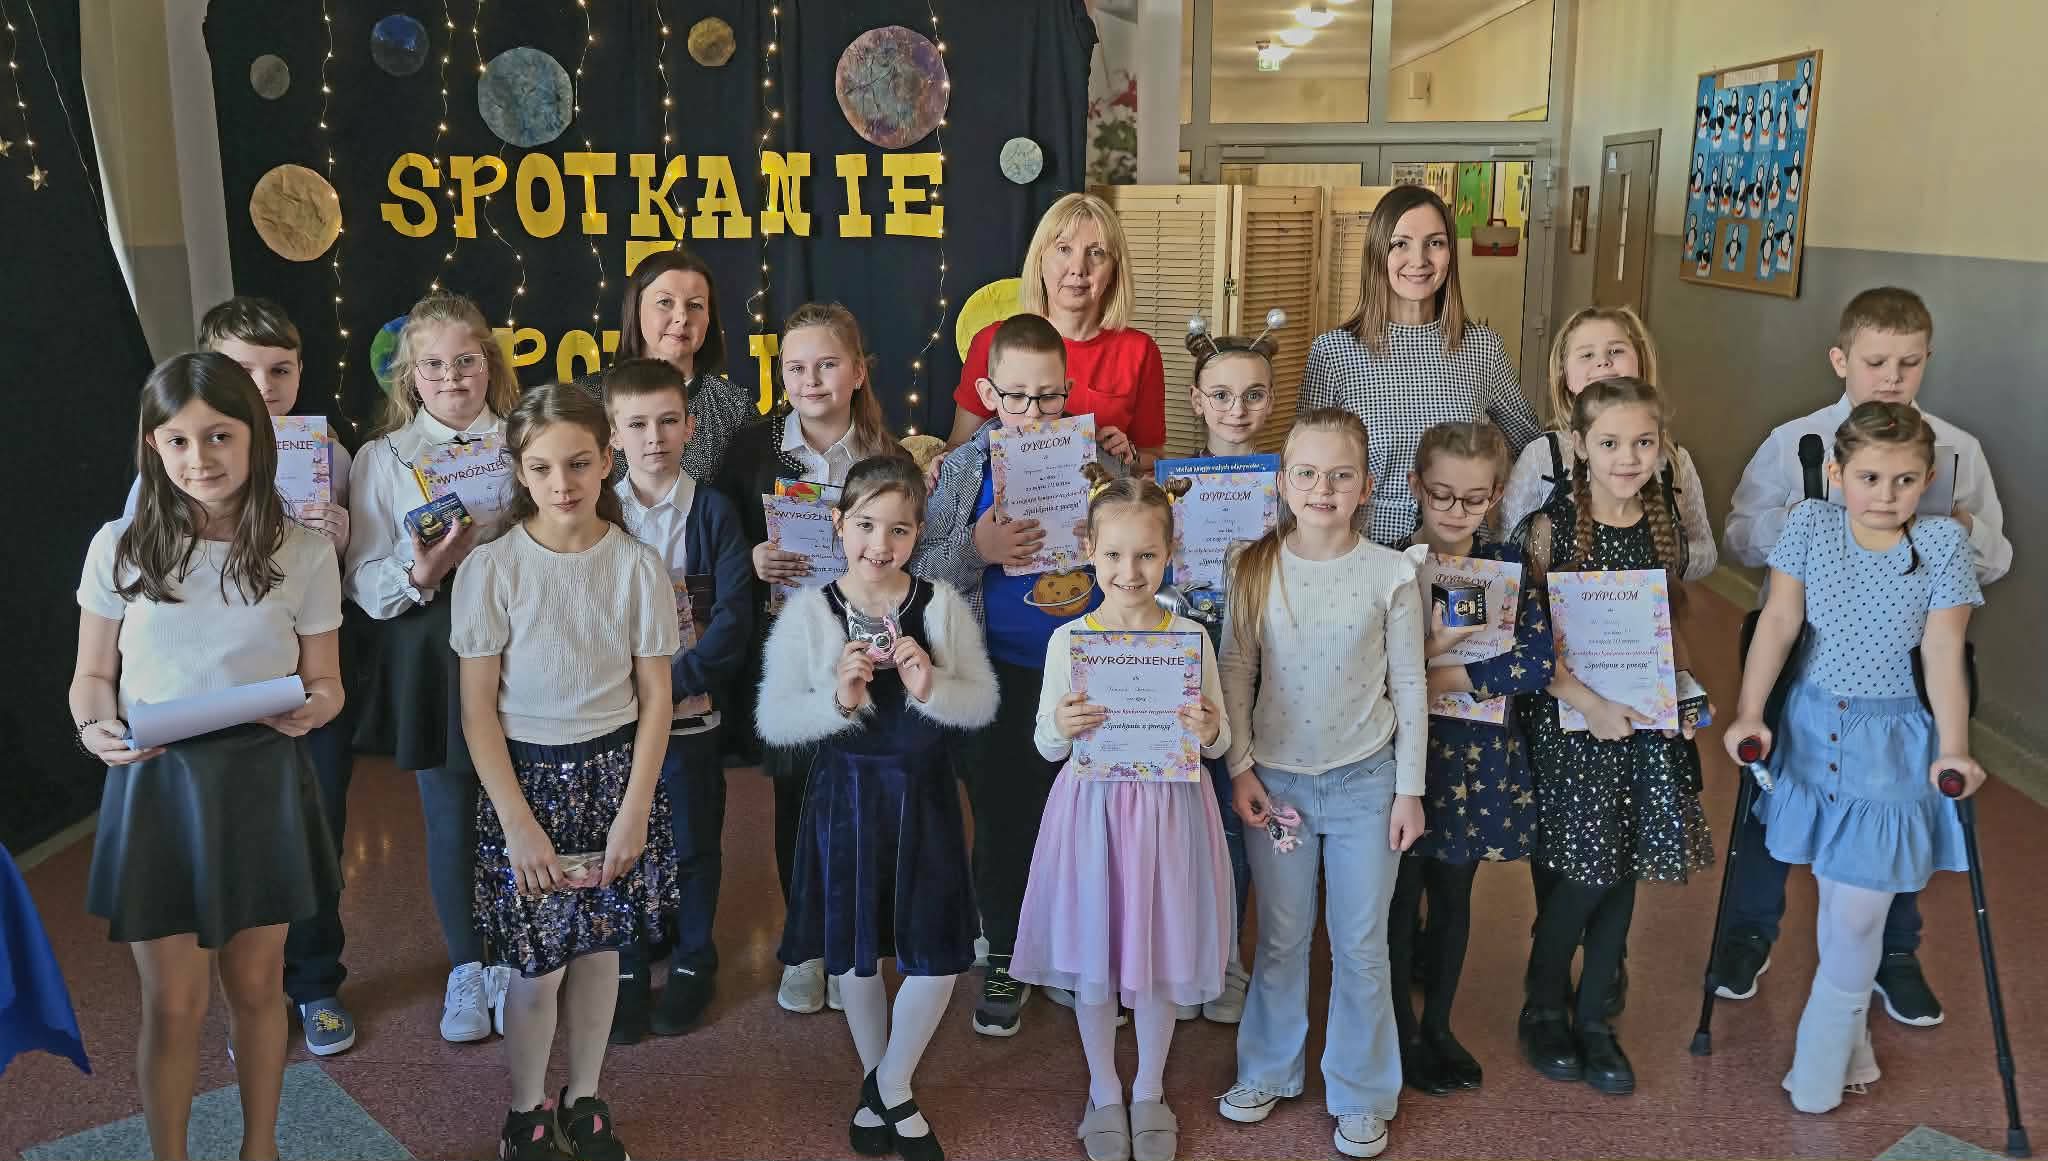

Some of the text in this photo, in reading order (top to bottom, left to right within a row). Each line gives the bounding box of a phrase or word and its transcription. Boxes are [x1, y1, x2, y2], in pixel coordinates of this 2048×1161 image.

[380, 152, 945, 239] SPOTKANIE
[1020, 436, 1071, 453] DYPLOM
[440, 460, 506, 484] WYRÓŻNIE
[1199, 490, 1252, 501] DYPLOM
[1581, 590, 1639, 601] DYPLOM
[1087, 653, 1185, 666] WYRÓŻNIENIE
